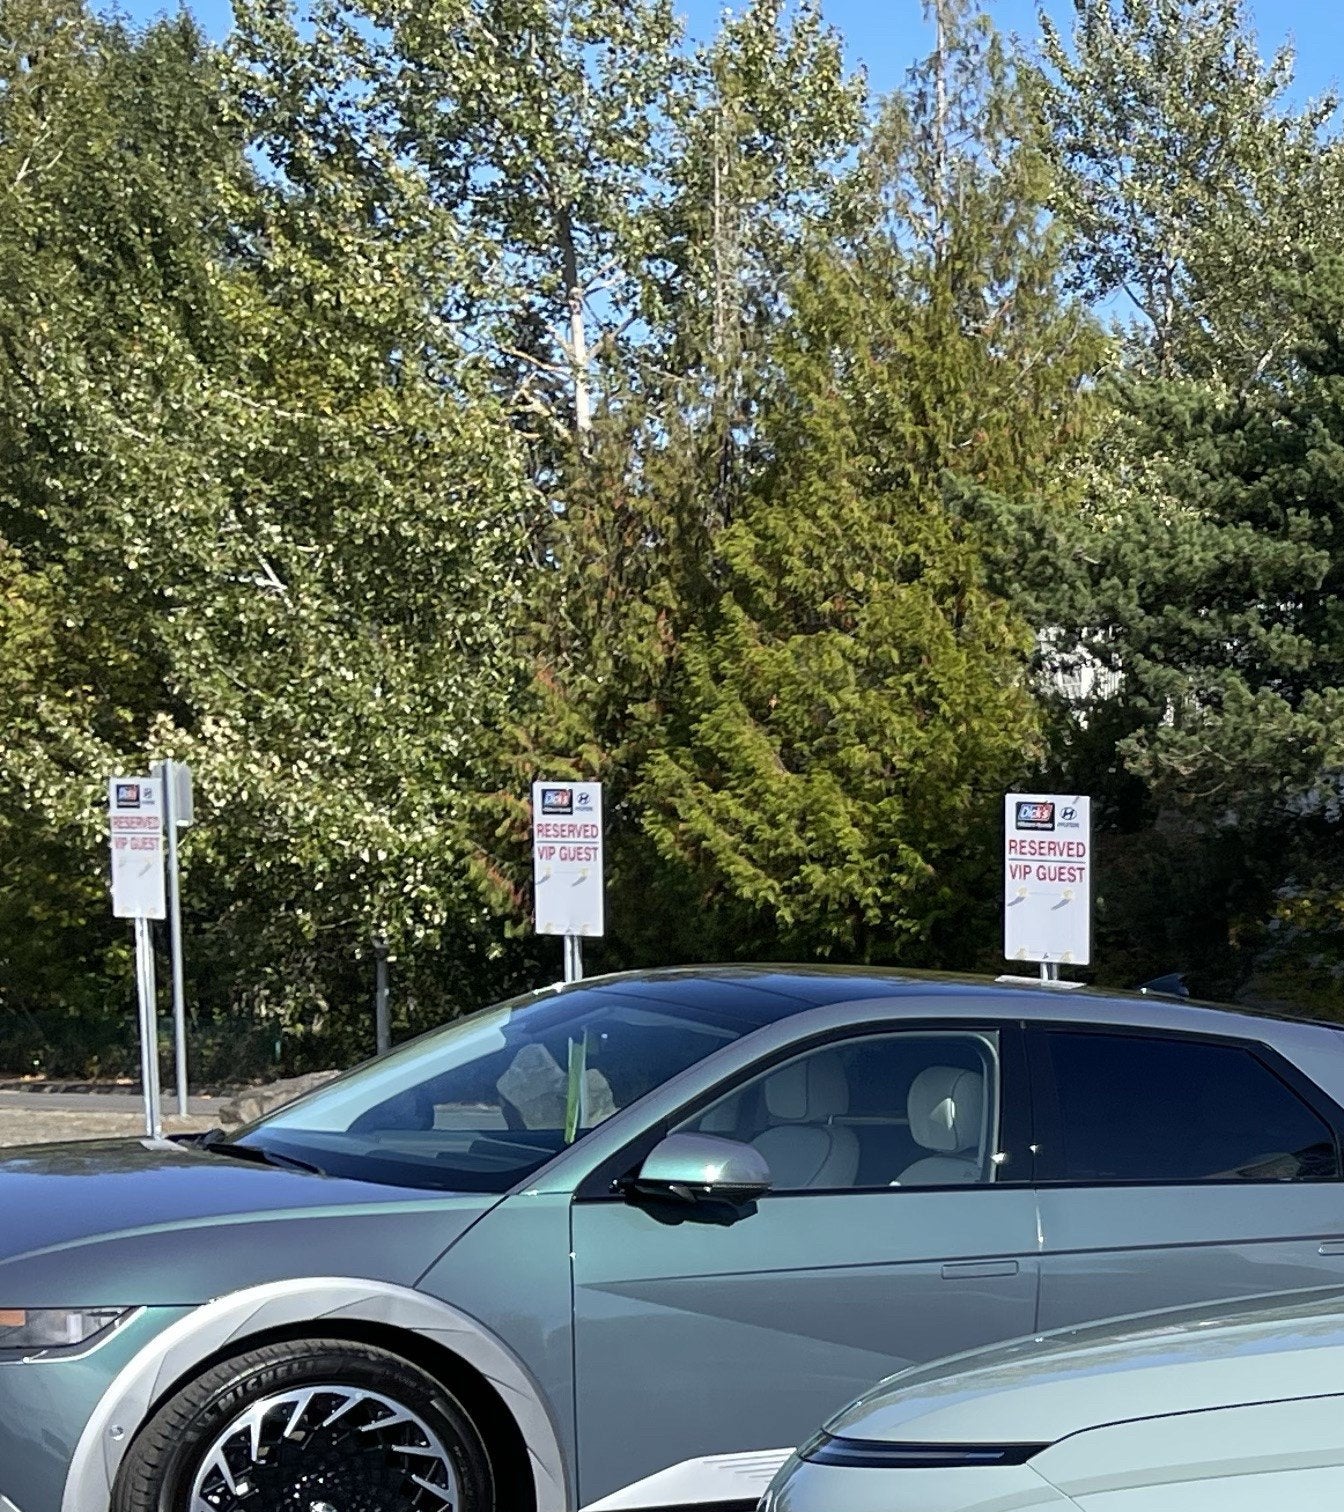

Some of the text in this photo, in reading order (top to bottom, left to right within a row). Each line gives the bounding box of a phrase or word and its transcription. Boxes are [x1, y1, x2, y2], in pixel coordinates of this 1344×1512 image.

[536, 823, 599, 839] RESERVED
[537, 846, 599, 862] VIP GUEST
[1008, 839, 1087, 858] RESERVED
[1009, 864, 1086, 883] VIP GUEST
